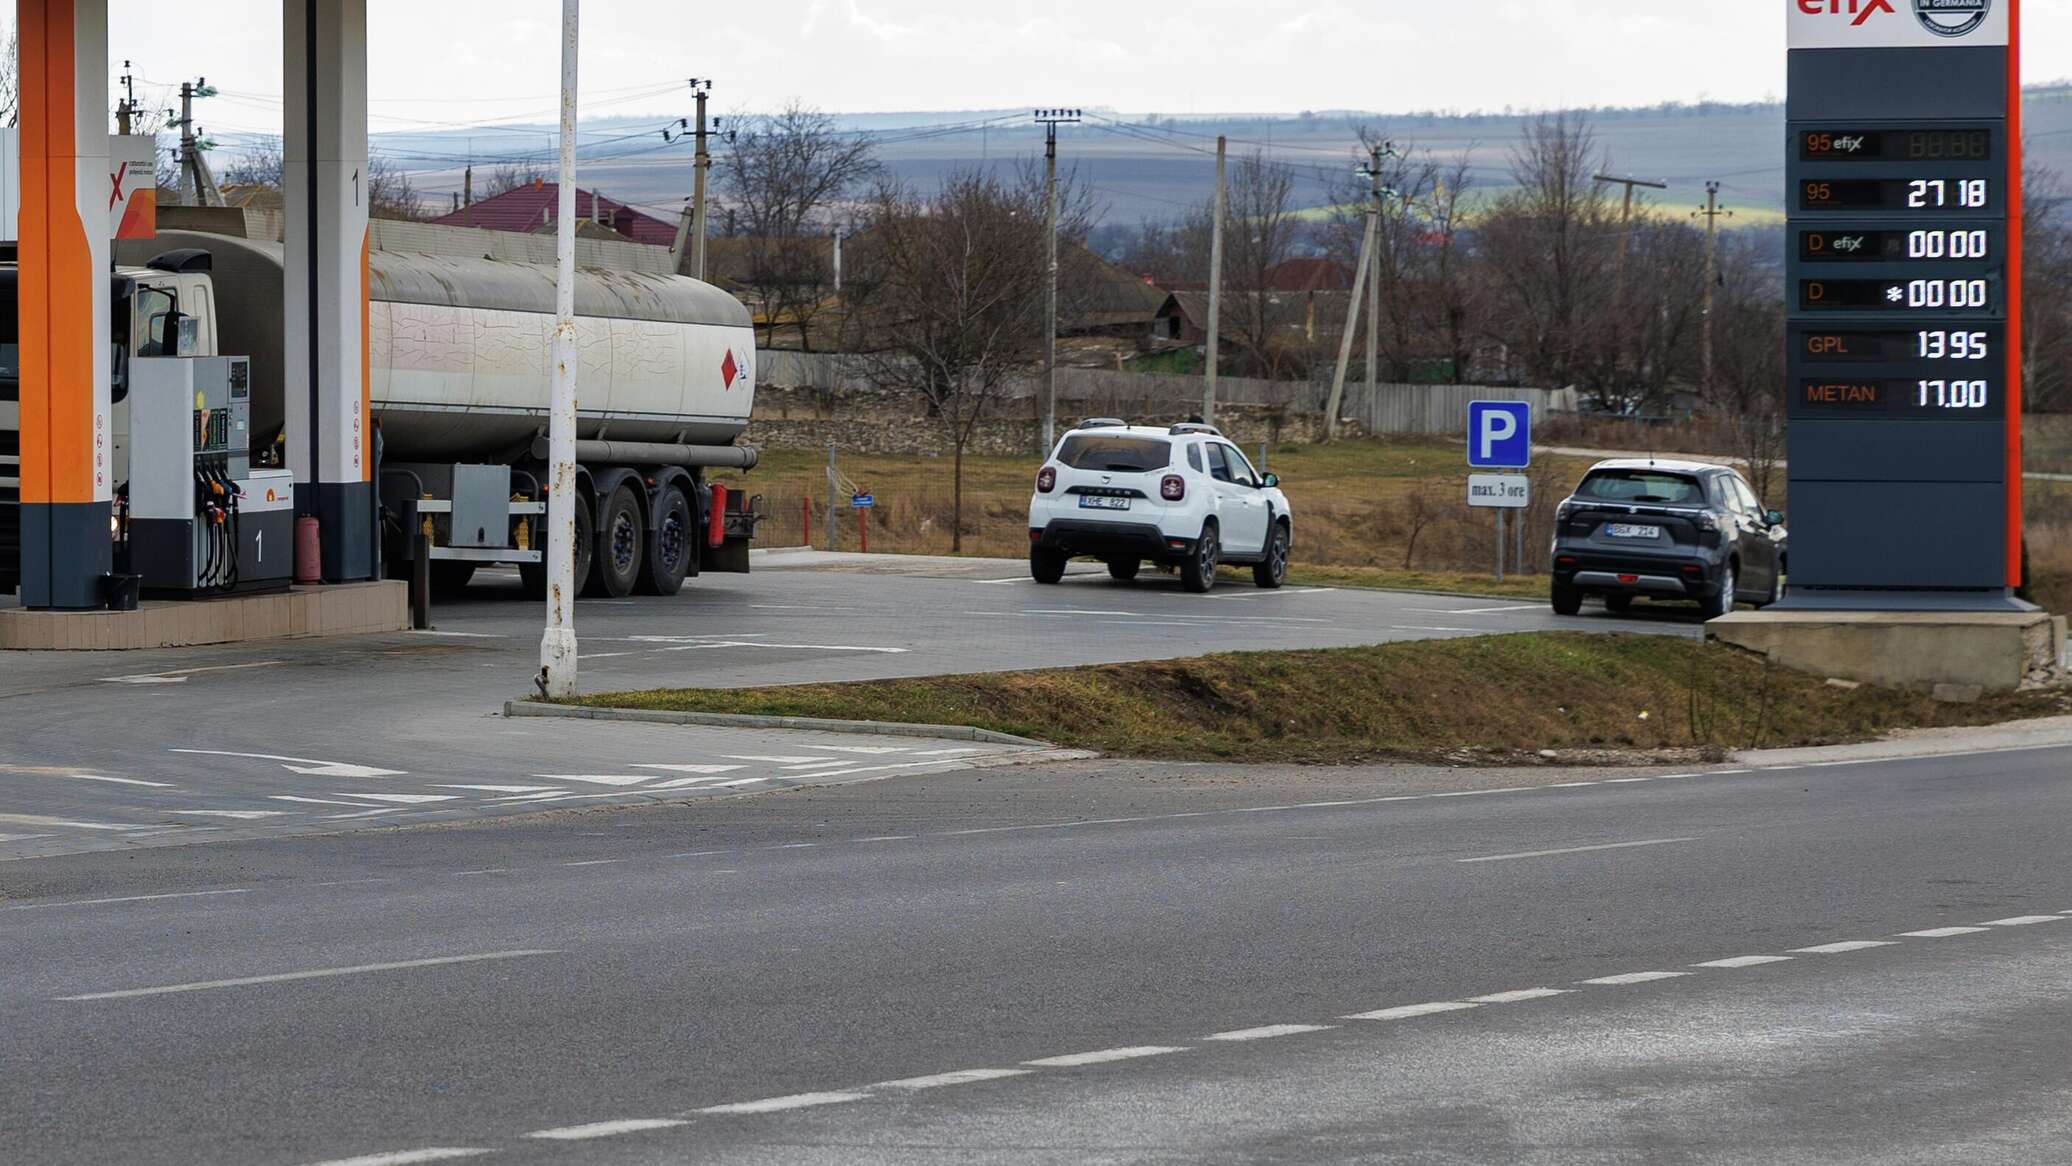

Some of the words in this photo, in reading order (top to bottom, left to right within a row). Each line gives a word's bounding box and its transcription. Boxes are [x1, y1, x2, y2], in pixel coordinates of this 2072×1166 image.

[1807, 134, 1831, 151] 95
[1833, 135, 1864, 152] efix
[352, 168, 359, 207] 1
[1807, 183, 1830, 199] 95
[1809, 234, 1823, 251] D
[1833, 236, 1864, 252] efix
[1809, 283, 1823, 299] D
[1807, 336, 1848, 353] GPL
[1807, 385, 1875, 401] METAN
[1918, 380, 1987, 408] 17.00
[1481, 409, 1517, 459] P
[1472, 485, 1497, 497] max.
[1498, 482, 1505, 497] 3
[1507, 486, 1525, 497] ore
[255, 529, 263, 563] 1
